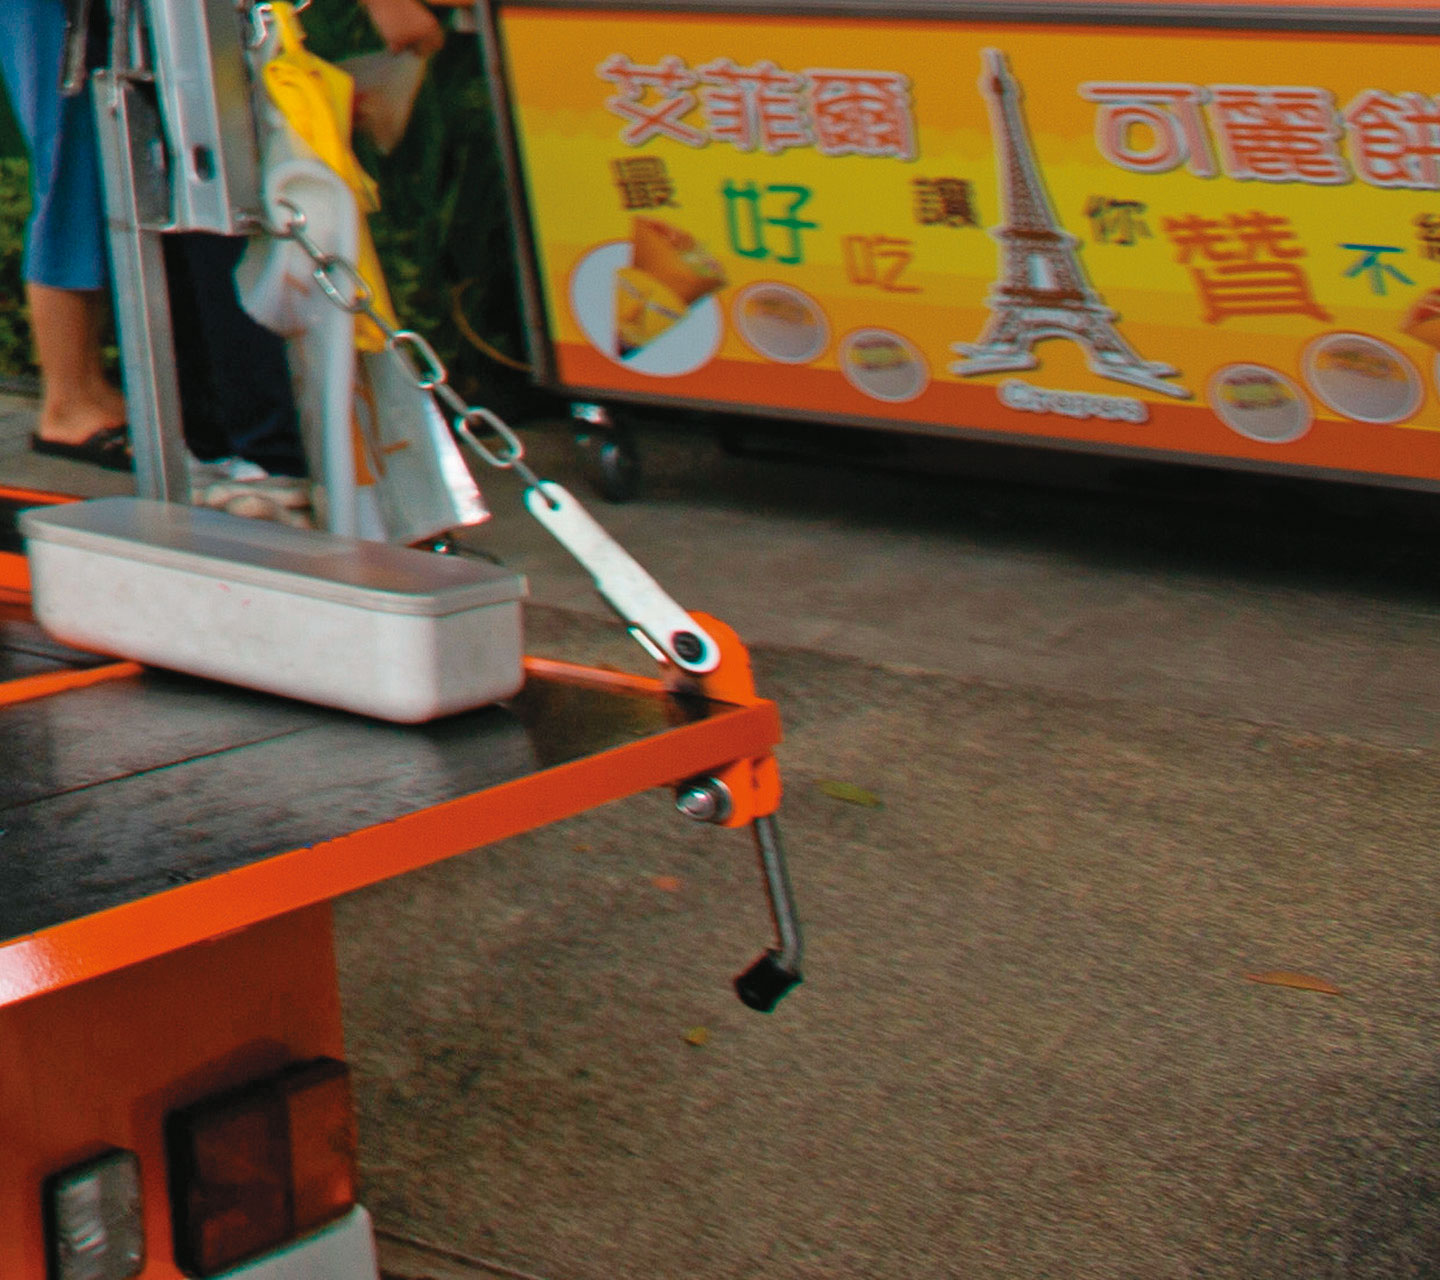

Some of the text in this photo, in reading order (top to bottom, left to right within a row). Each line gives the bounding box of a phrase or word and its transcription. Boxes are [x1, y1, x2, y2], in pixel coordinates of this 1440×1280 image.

[599, 56, 1440, 190] 艾菲爾 可麗餅
